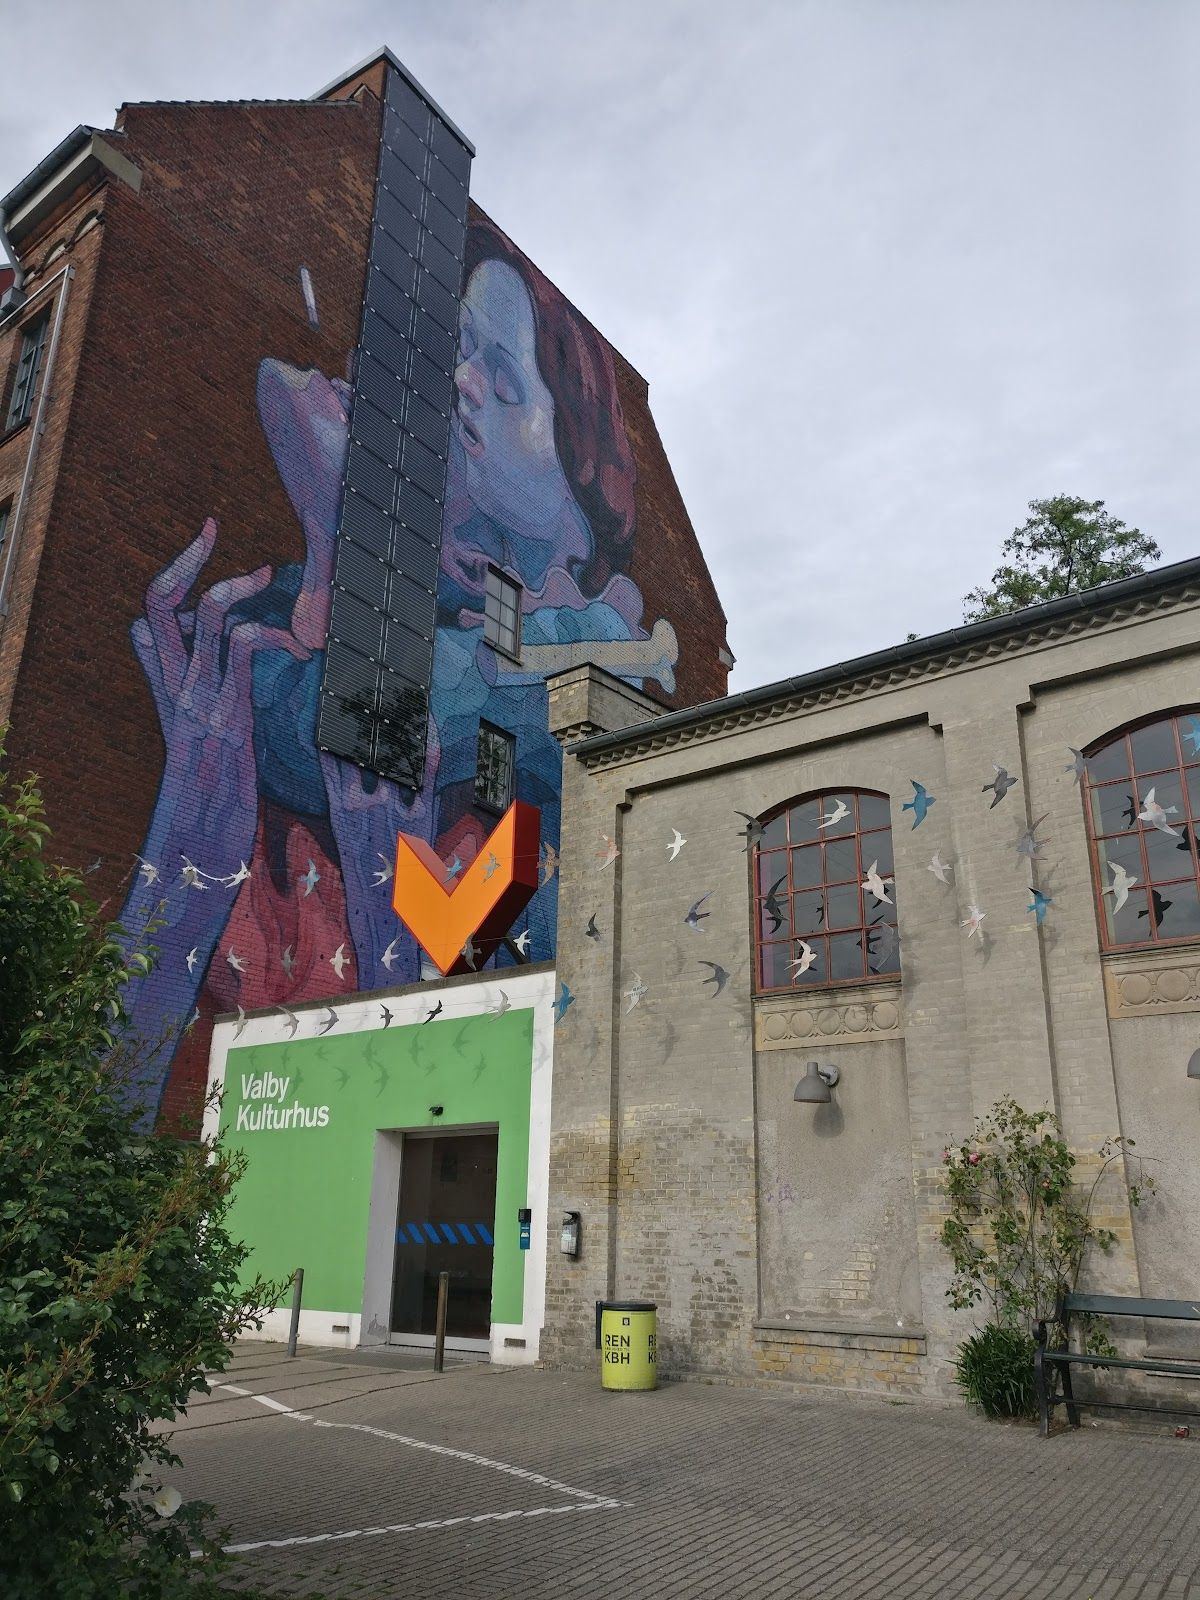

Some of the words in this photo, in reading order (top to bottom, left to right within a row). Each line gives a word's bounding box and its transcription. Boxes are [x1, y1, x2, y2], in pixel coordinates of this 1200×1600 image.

[241, 1071, 290, 1104] Valby
[236, 1100, 330, 1131] Kulturhus
[605, 1334, 630, 1347] REN
[605, 1351, 630, 1364] KBH
